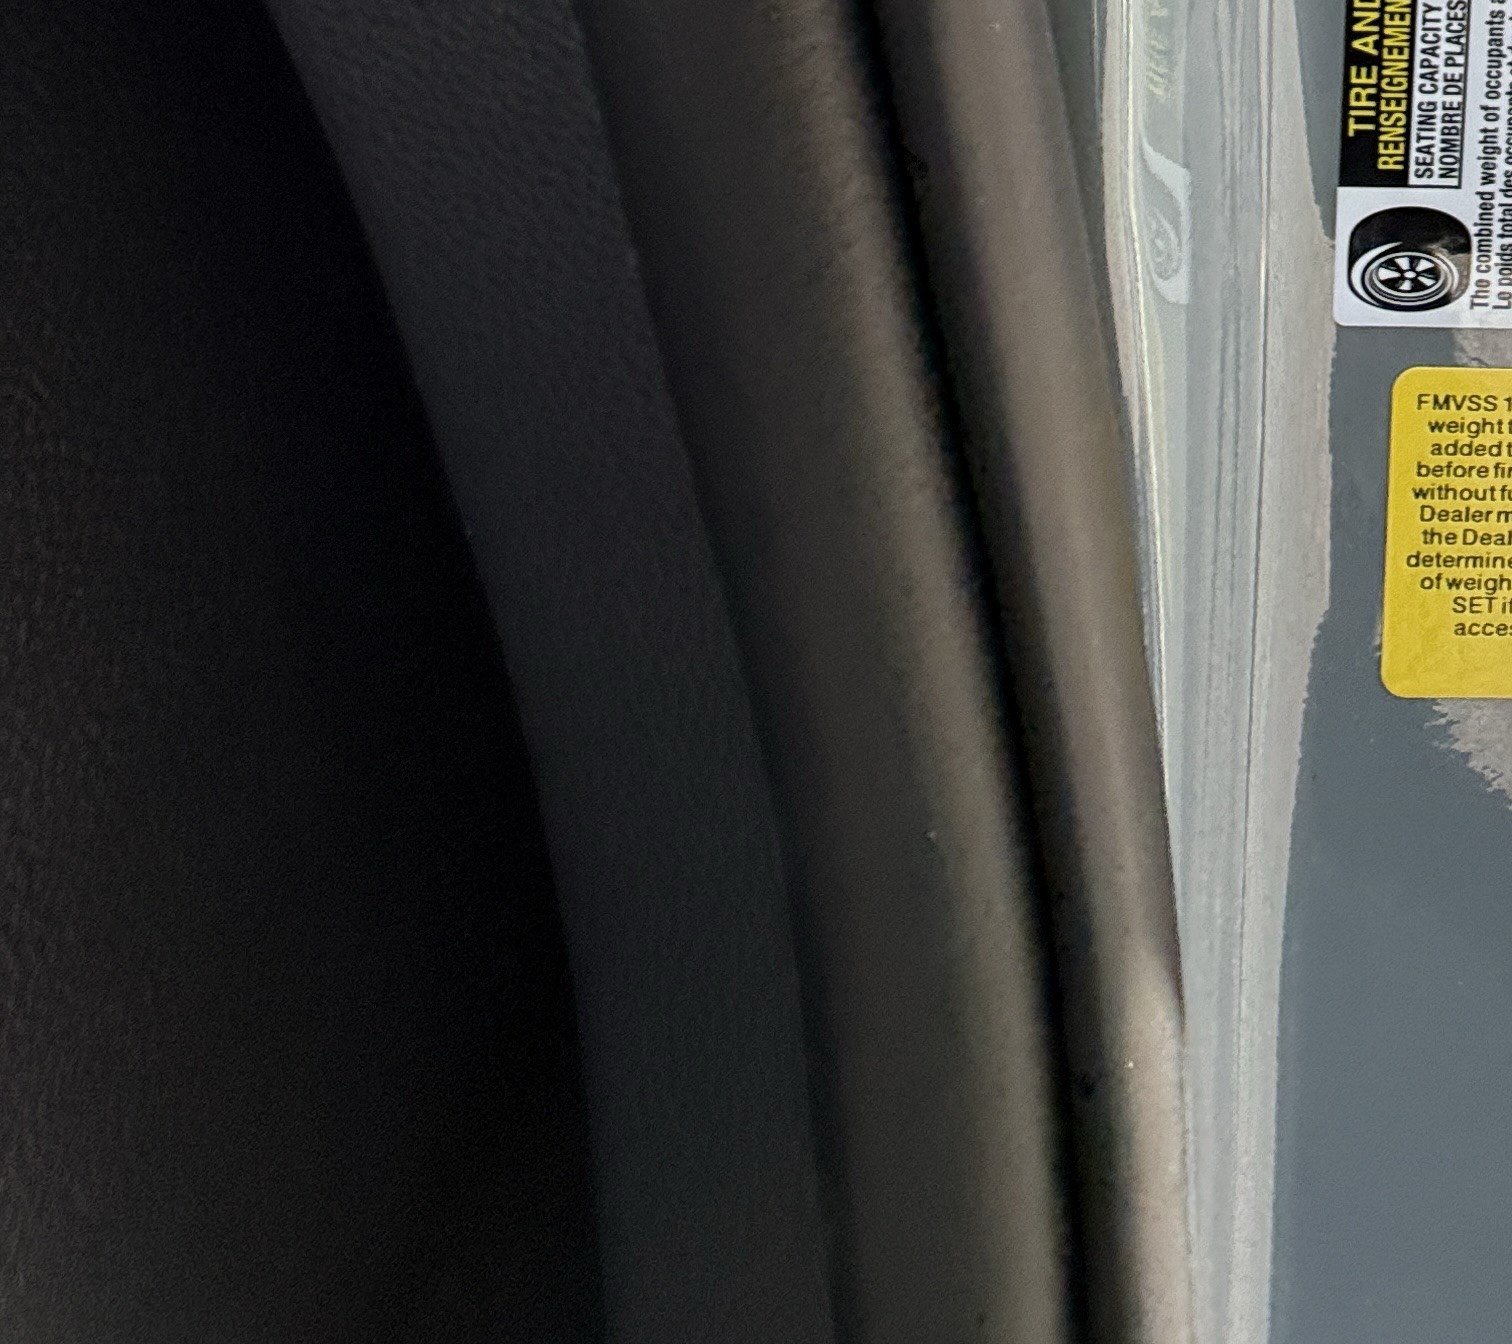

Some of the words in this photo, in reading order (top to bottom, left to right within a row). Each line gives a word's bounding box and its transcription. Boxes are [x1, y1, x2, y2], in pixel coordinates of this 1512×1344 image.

[1417, 2, 1443, 95] CAPACITY
[1484, 9, 1508, 100] occupants
[1347, 65, 1378, 137] TIRE
[1479, 104, 1501, 123] of
[1413, 101, 1438, 179] SEATING
[1476, 127, 1503, 186] weight
[1473, 190, 1496, 274] combined
[1416, 393, 1498, 412] FMVSS
[1427, 416, 1504, 440] weight
[1430, 439, 1503, 458] added
[1415, 460, 1490, 479] before
[1411, 483, 1497, 502] without
[1419, 504, 1494, 523] Dealer
[1421, 527, 1458, 546] the
[1451, 595, 1499, 614] SET
